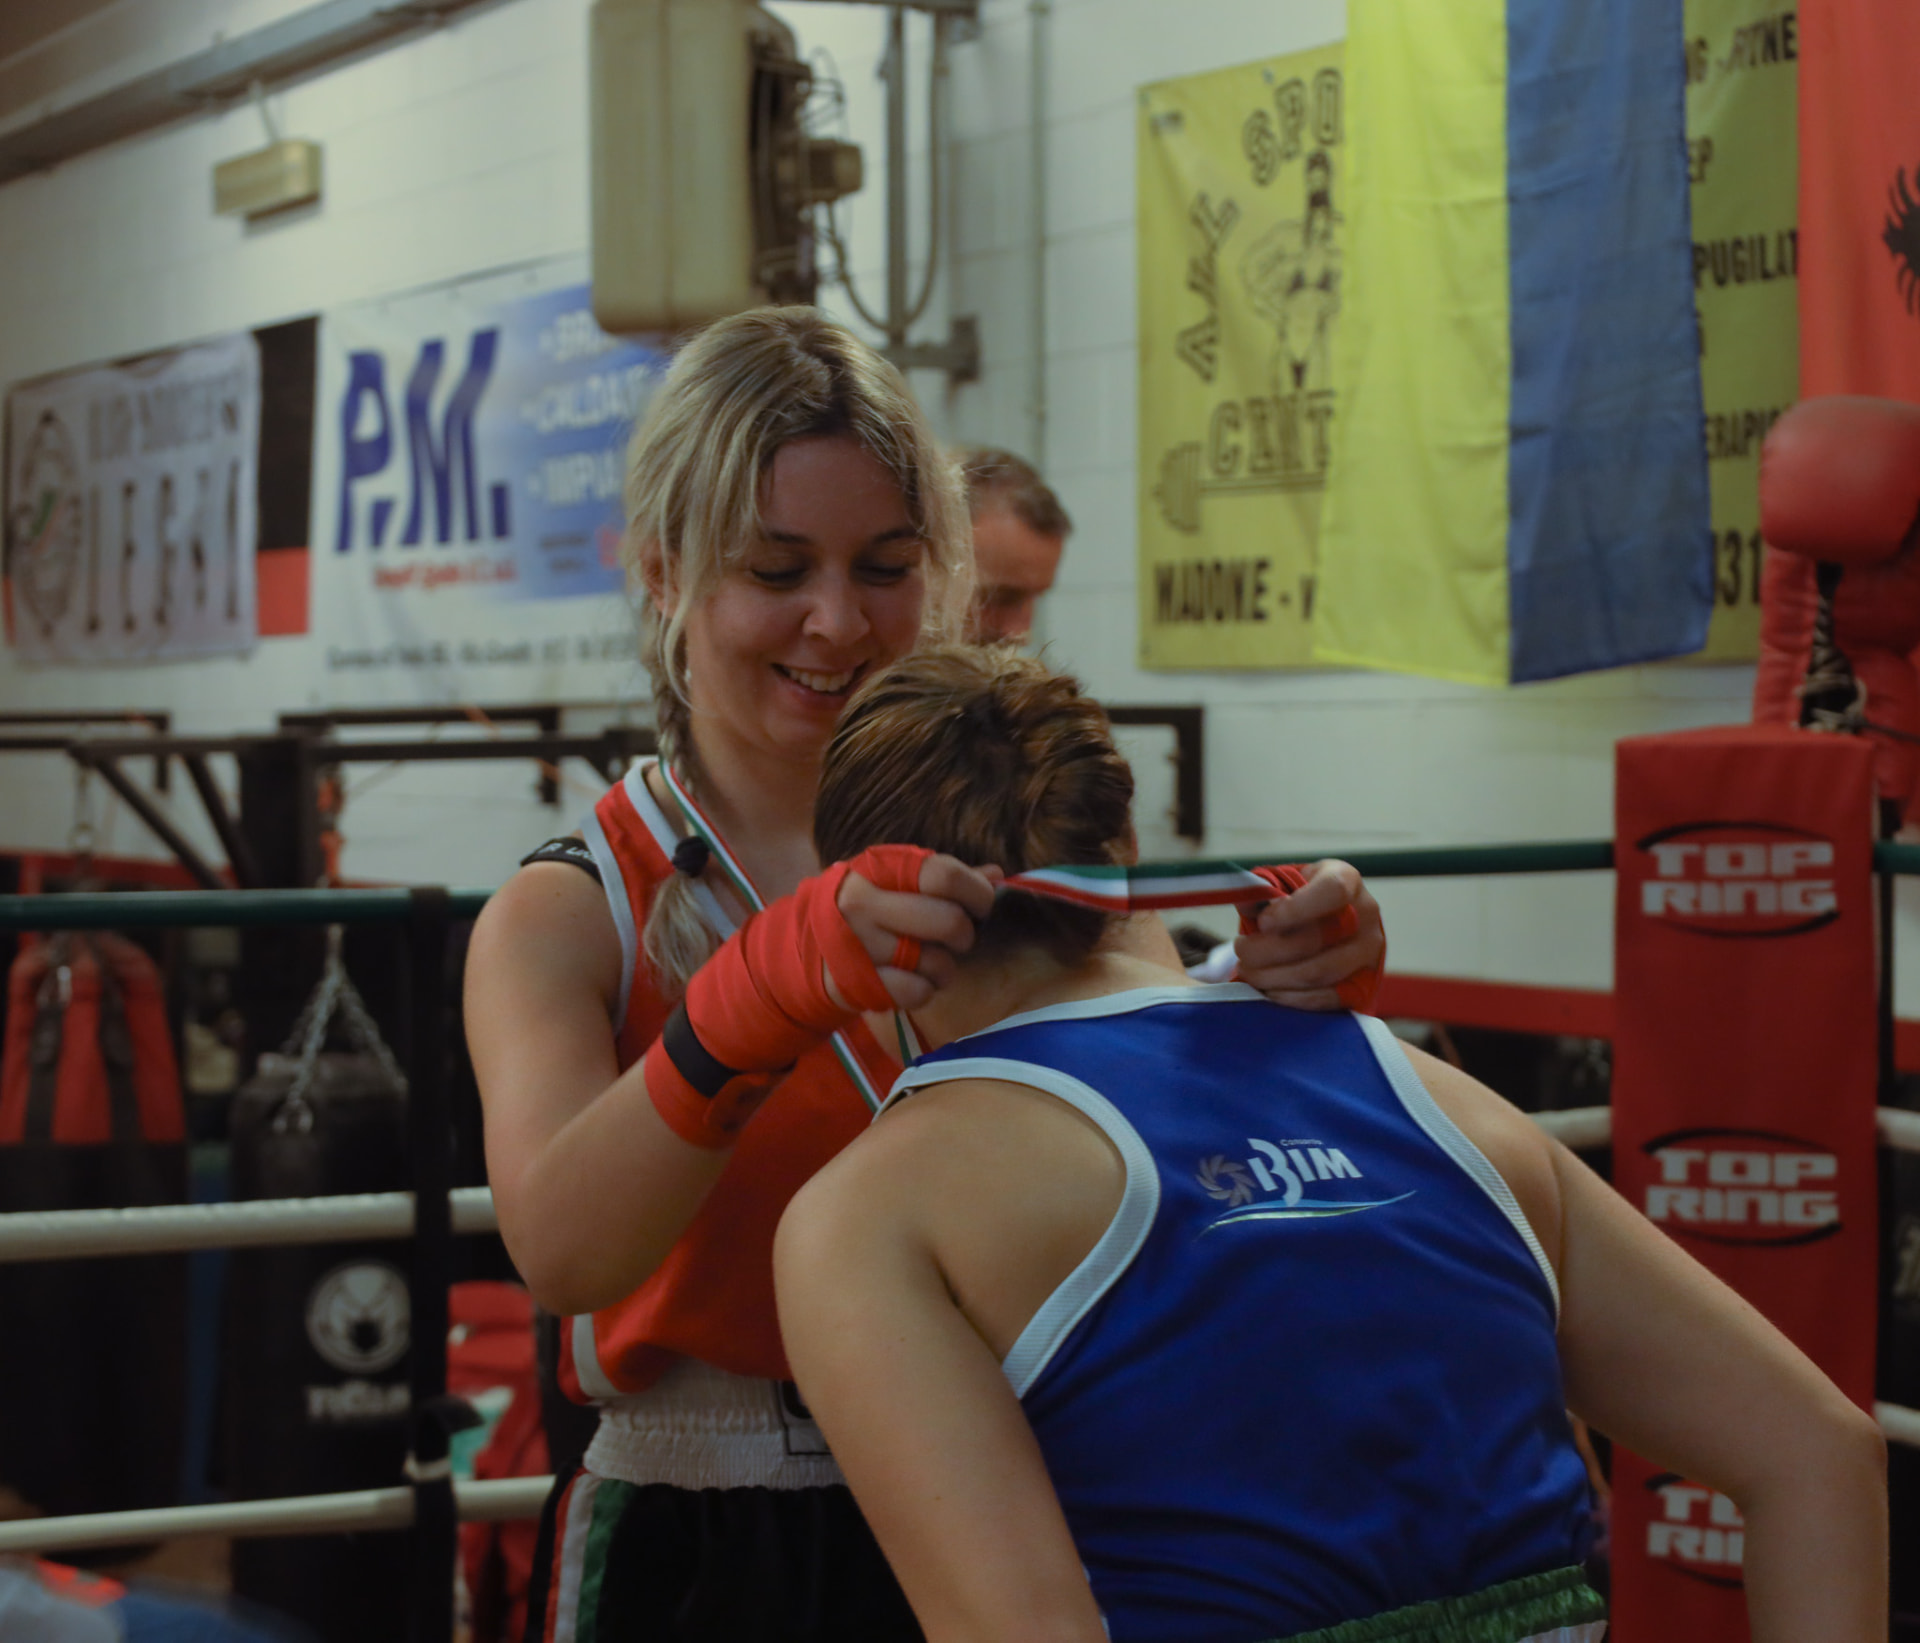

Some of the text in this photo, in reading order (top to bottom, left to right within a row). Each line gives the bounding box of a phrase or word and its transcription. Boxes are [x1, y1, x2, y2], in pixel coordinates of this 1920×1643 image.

[336, 327, 511, 552] P.M.
[1649, 841, 1835, 877] TOP
[1641, 879, 1839, 917] RING
[1246, 1138, 1364, 1208] BIM
[1654, 1148, 1838, 1187] TOP
[1646, 1185, 1840, 1226] RING
